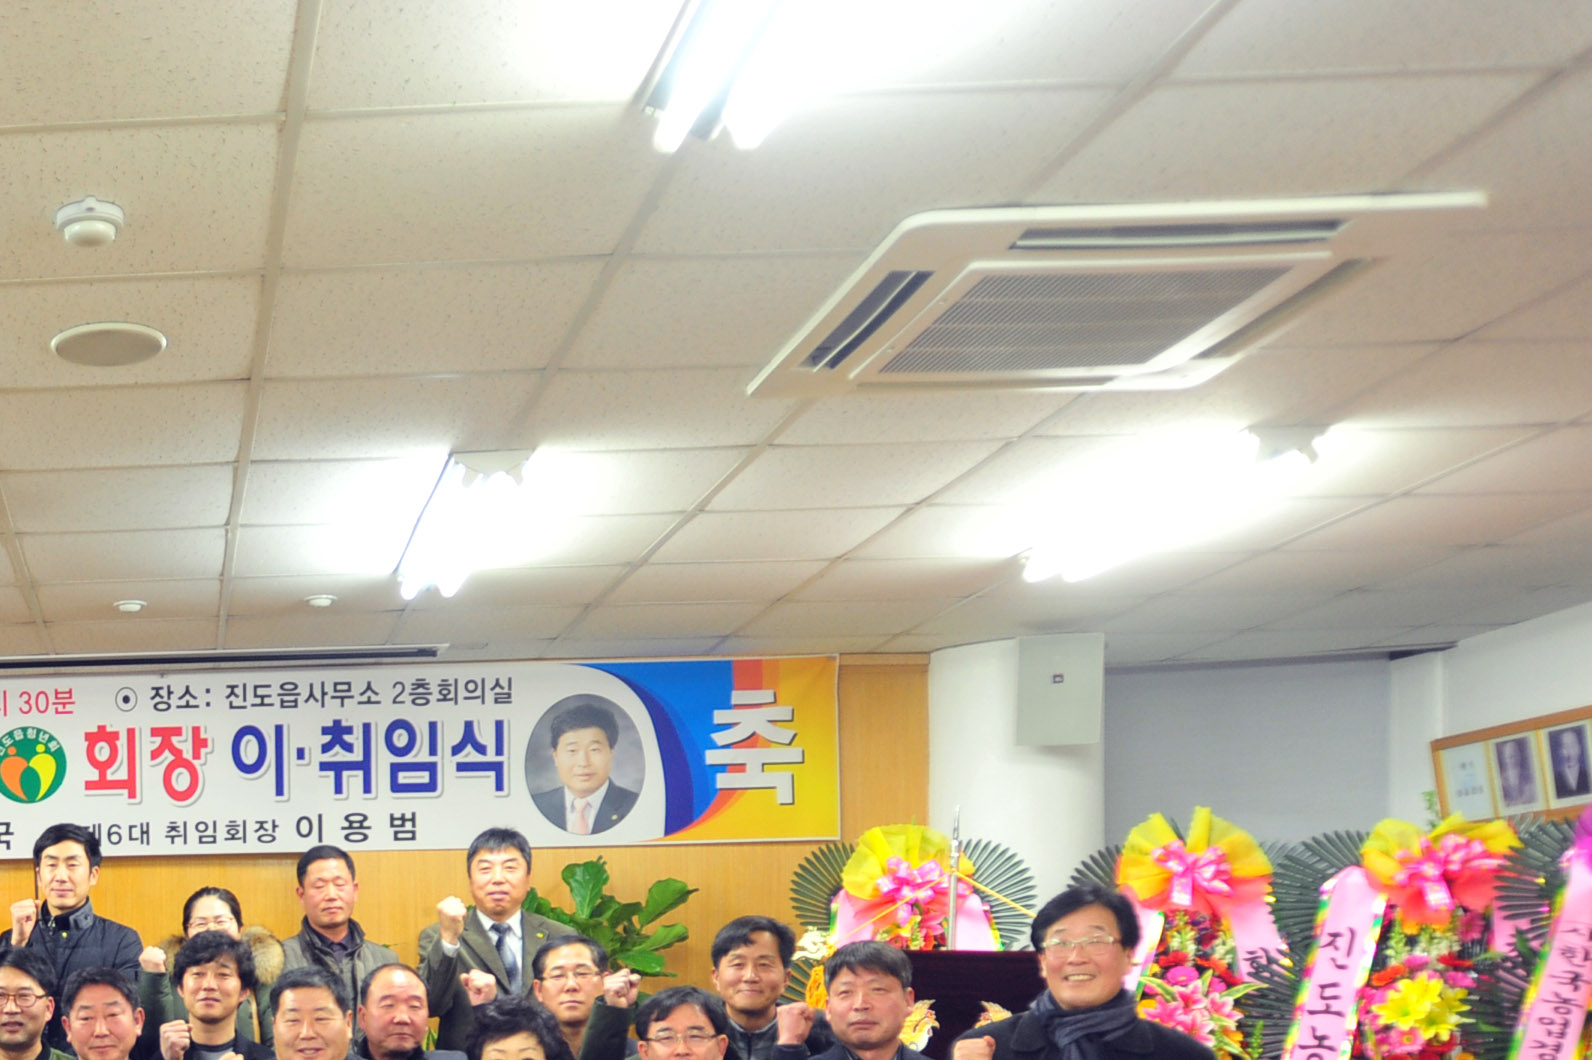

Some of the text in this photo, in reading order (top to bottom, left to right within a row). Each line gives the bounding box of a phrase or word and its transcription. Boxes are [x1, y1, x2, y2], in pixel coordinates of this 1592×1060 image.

[18, 687, 76, 715] 30분
[149, 676, 513, 712] 장소: 진도읍사무소 2층회의실
[83, 724, 210, 803] 회장
[704, 689, 805, 806] 축
[164, 819, 280, 846] 취임회장
[295, 811, 418, 844] 이용범
